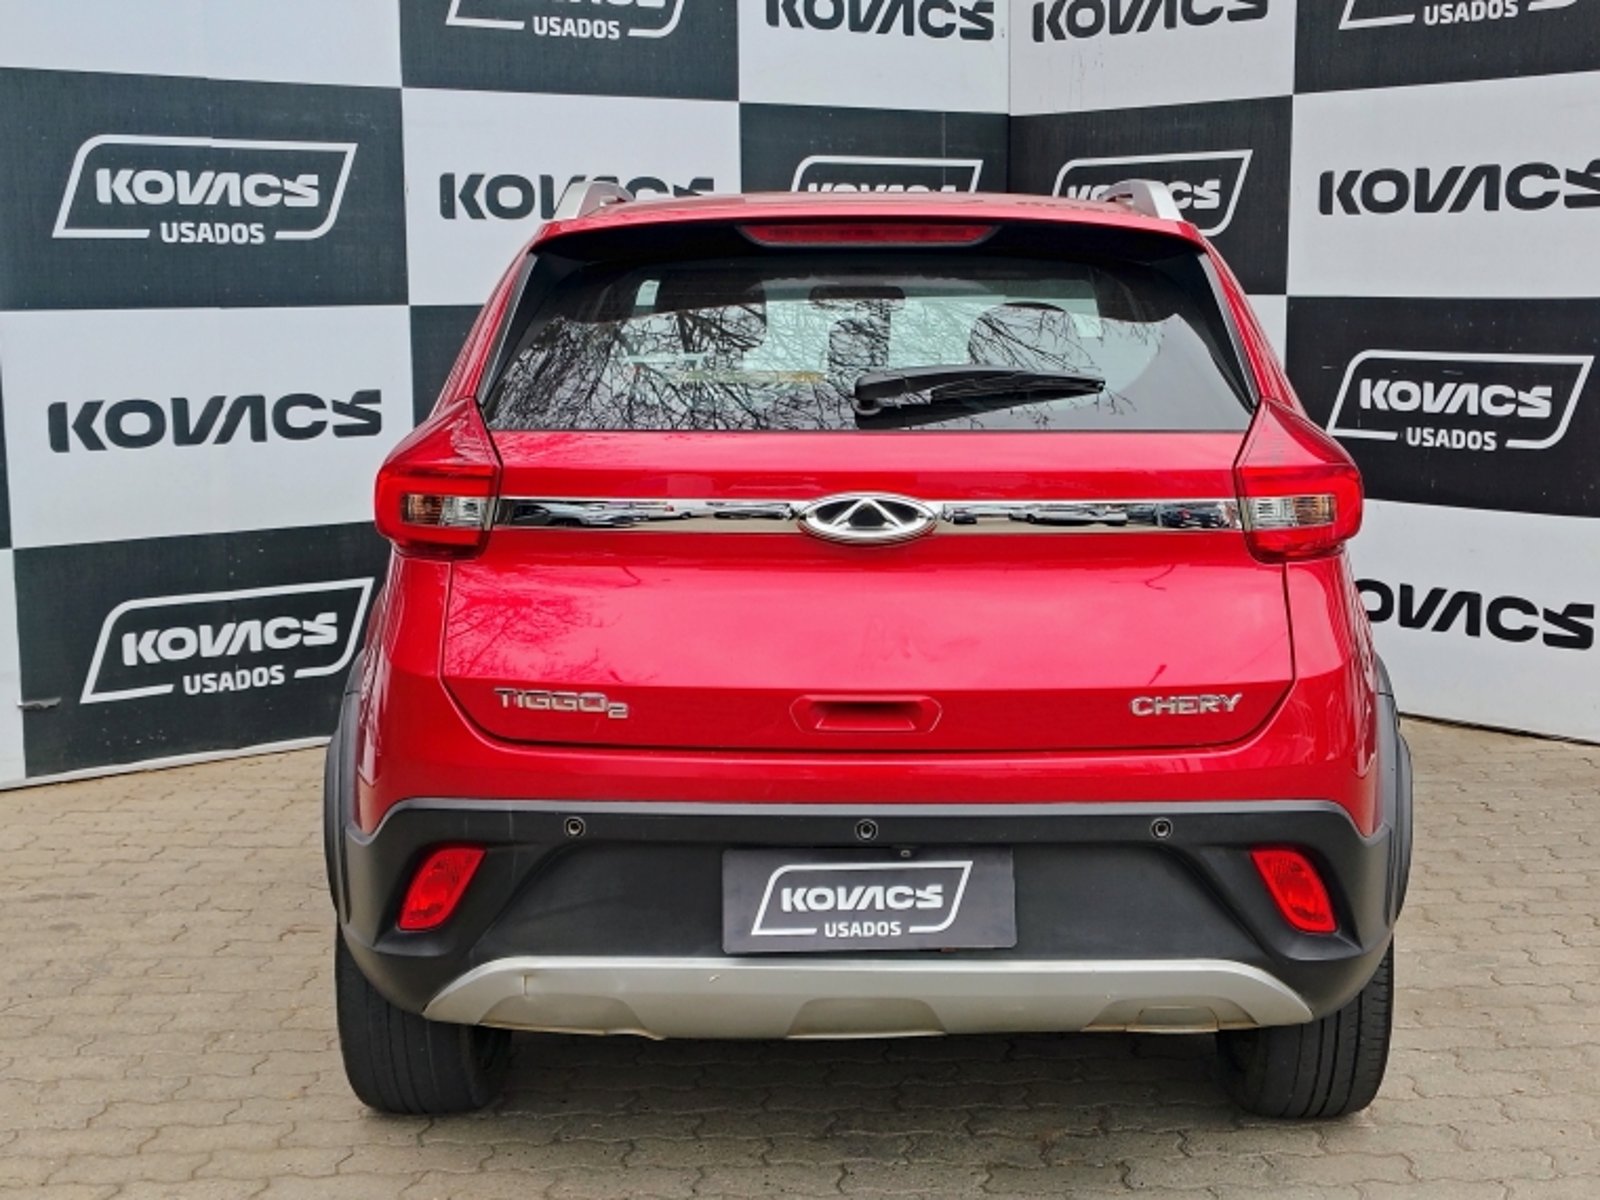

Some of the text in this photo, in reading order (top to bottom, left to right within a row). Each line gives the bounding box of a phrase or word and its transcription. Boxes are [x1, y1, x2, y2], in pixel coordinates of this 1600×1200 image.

[532, 16, 620, 39] USADOS
[766, 0, 995, 41] KOVACS
[1423, 0, 1519, 26] USADOS
[96, 168, 319, 207] KOVACS
[1318, 159, 1600, 215] KOVACS
[160, 222, 265, 244] USADOS
[1360, 378, 1553, 418] KOVACS
[47, 389, 382, 453] KOVACS
[1406, 426, 1497, 451] USADOS
[1354, 578, 1595, 650] OVACS
[121, 611, 338, 666] KOVACS
[182, 664, 285, 696] USADOS
[1130, 692, 1243, 717] CHERY
[780, 884, 944, 912] KOVACS
[824, 921, 902, 938] USADOS
